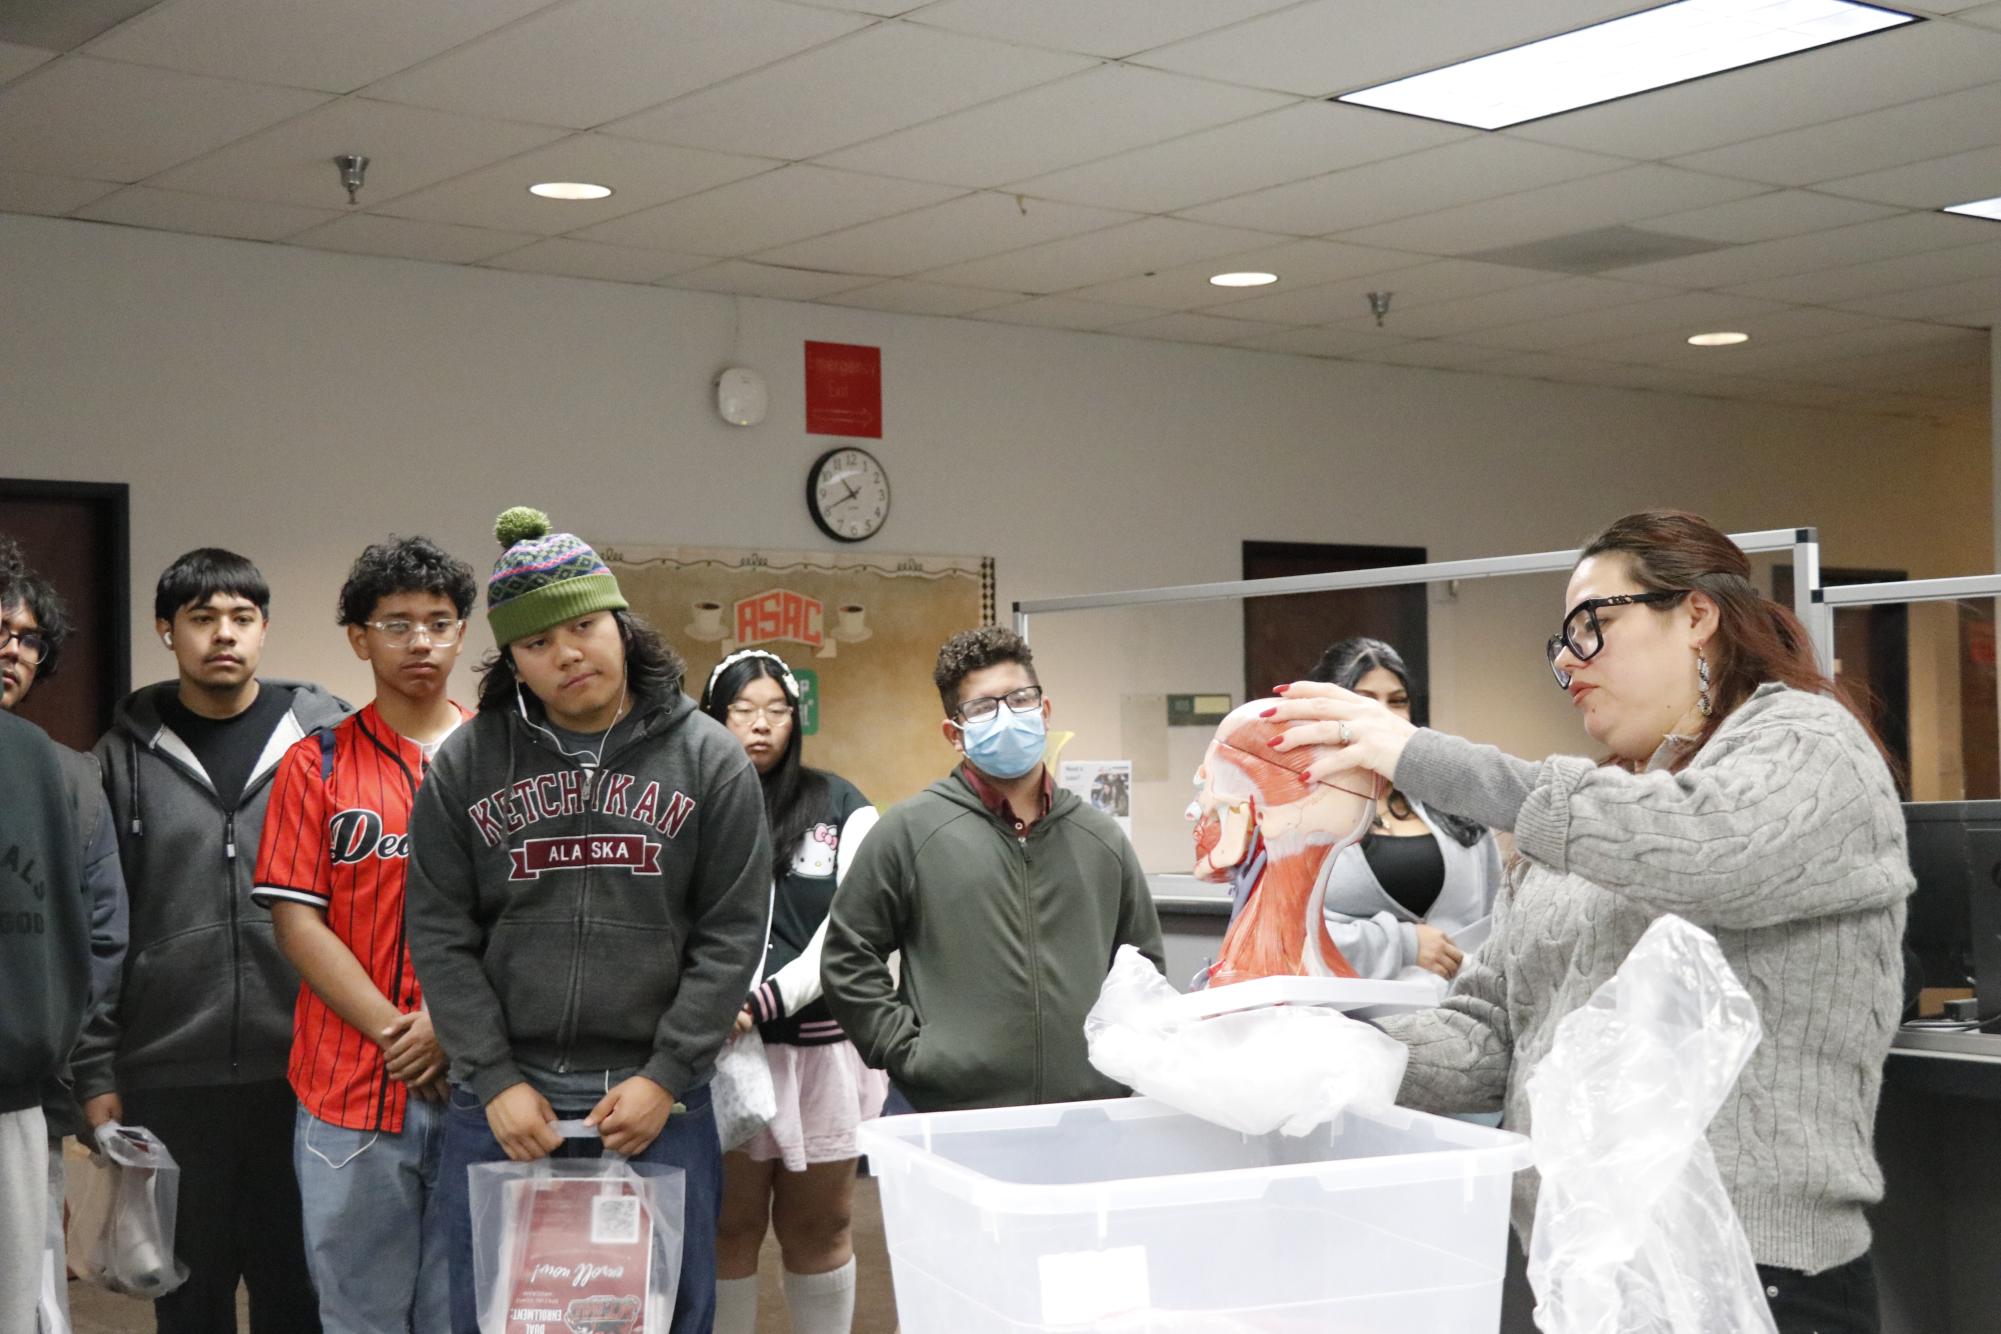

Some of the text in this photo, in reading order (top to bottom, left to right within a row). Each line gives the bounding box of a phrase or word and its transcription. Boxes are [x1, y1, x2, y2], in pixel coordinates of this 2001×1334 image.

[833, 458, 842, 471] 11
[846, 453, 858, 466] 12
[863, 460, 868, 473] 1
[822, 470, 833, 483] 10
[873, 471, 880, 484] 2
[819, 488, 827, 499] 9
[879, 488, 886, 502] 3
[823, 504, 833, 518] 8
[874, 506, 881, 518] 4
[837, 518, 845, 532] 7
[850, 525, 858, 537] 6
[864, 519, 872, 532] 5
[737, 590, 824, 646] ASAC
[468, 769, 696, 848] KETCHIKAN
[548, 841, 630, 863] ALASKA
[530, 1263, 625, 1288] enroll now!
